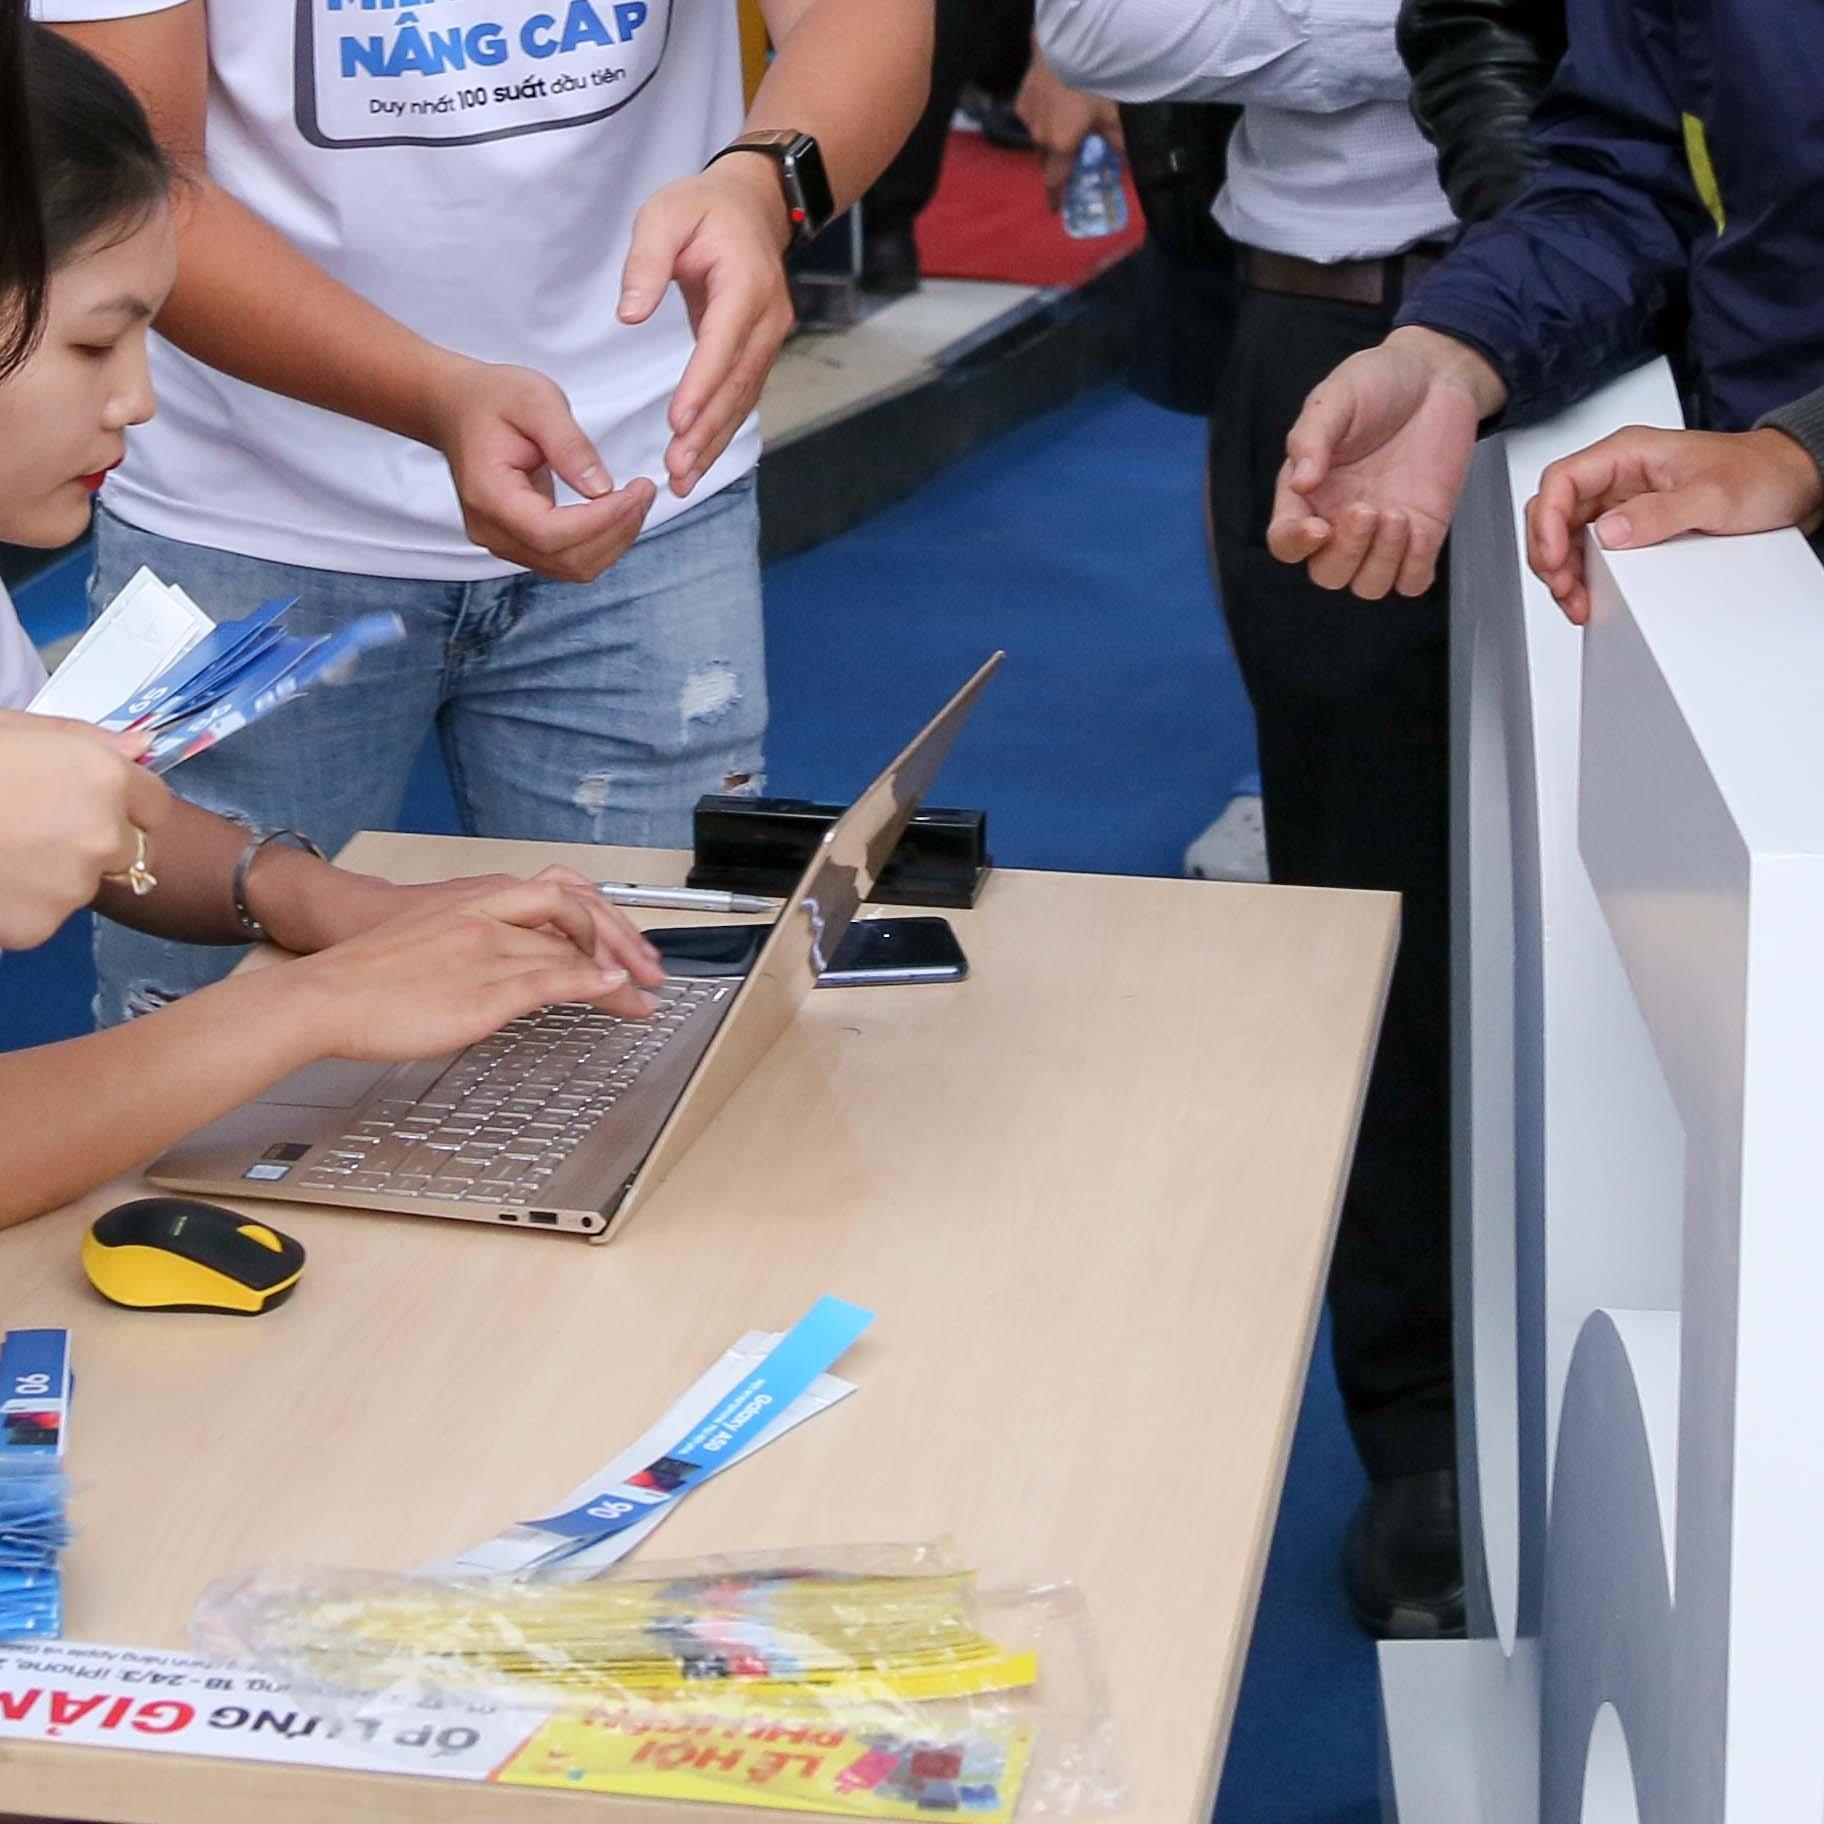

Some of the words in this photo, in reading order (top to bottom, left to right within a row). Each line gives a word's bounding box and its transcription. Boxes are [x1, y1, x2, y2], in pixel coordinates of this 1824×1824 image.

[339, 10, 508, 79] NÂNG
[369, 98, 406, 118] Duy
[411, 95, 455, 115] nhất
[457, 86, 488, 110] 100
[494, 74, 547, 103] suất
[549, 73, 588, 95] đầu
[590, 66, 627, 87] tiên
[13, 1658, 111, 1681] iPhone,
[205, 1676, 234, 1692] 18
